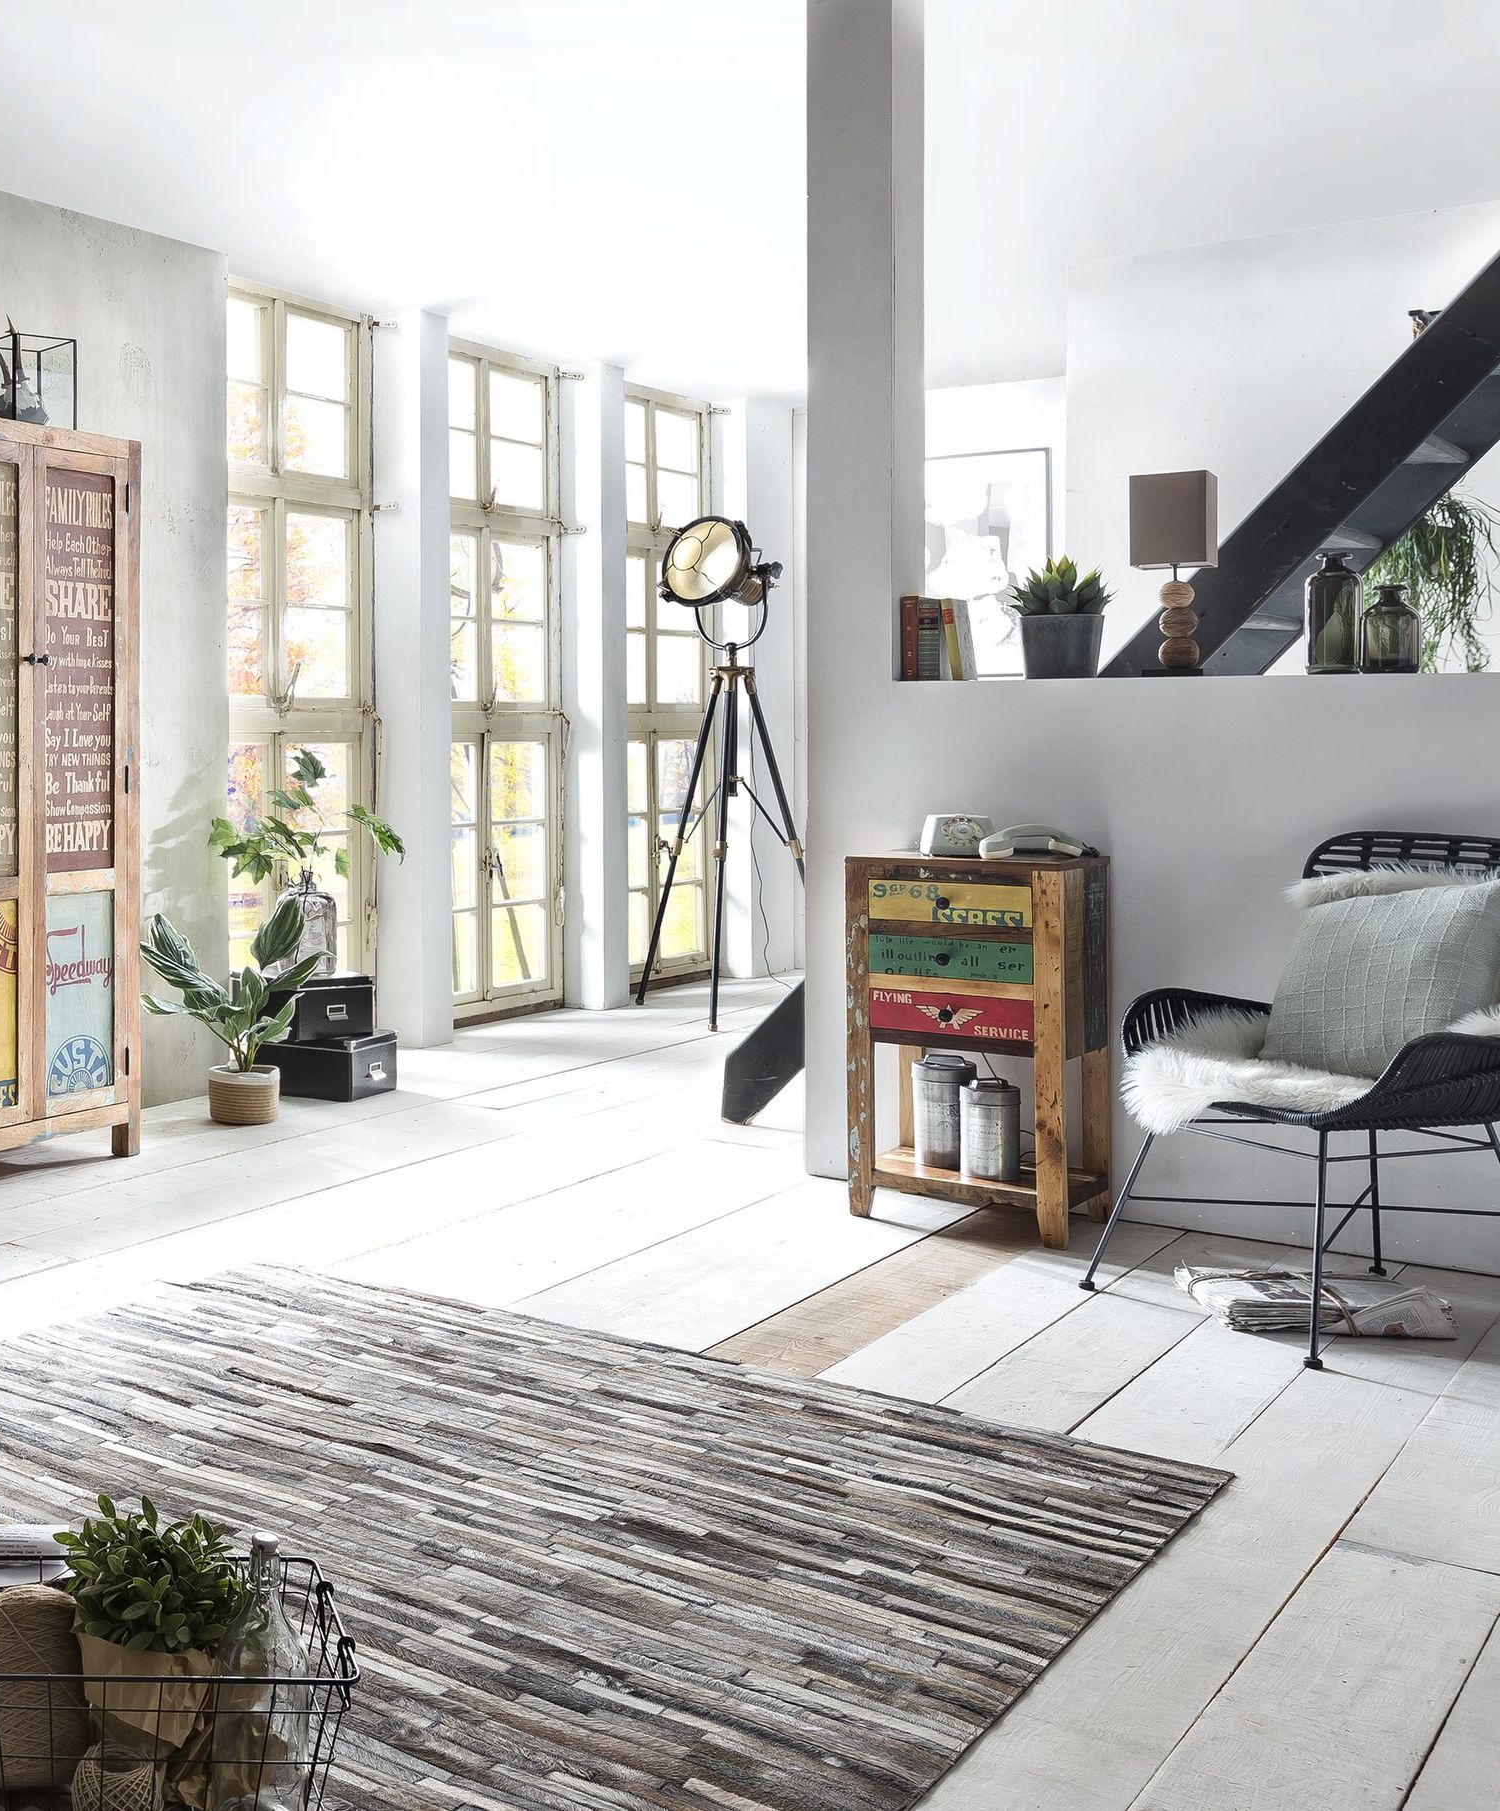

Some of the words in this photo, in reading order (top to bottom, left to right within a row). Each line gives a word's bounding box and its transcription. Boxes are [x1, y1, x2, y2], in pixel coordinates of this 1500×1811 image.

[45, 485, 87, 526] FAMILY
[45, 530, 63, 555] Help
[64, 532, 85, 553] Each
[85, 535, 113, 557] Other
[45, 554, 73, 579] Always
[45, 578, 112, 622] SHARE
[92, 702, 112, 722] Self
[45, 727, 62, 751] Say
[72, 728, 94, 747] Love
[92, 734, 112, 751] you
[61, 753, 80, 767] NEW
[81, 752, 112, 767] THINGS
[45, 771, 60, 795] Be
[64, 770, 111, 794] Thankful
[45, 799, 67, 817] Show
[66, 799, 112, 820] Compassion
[45, 823, 62, 854] BE
[62, 819, 112, 853] HAPPY
[46, 923, 114, 996] Speedway
[960, 955, 979, 968] all
[997, 961, 1025, 972] ser
[873, 990, 913, 1004] FLYING
[973, 1025, 1029, 1040] SERVICE
